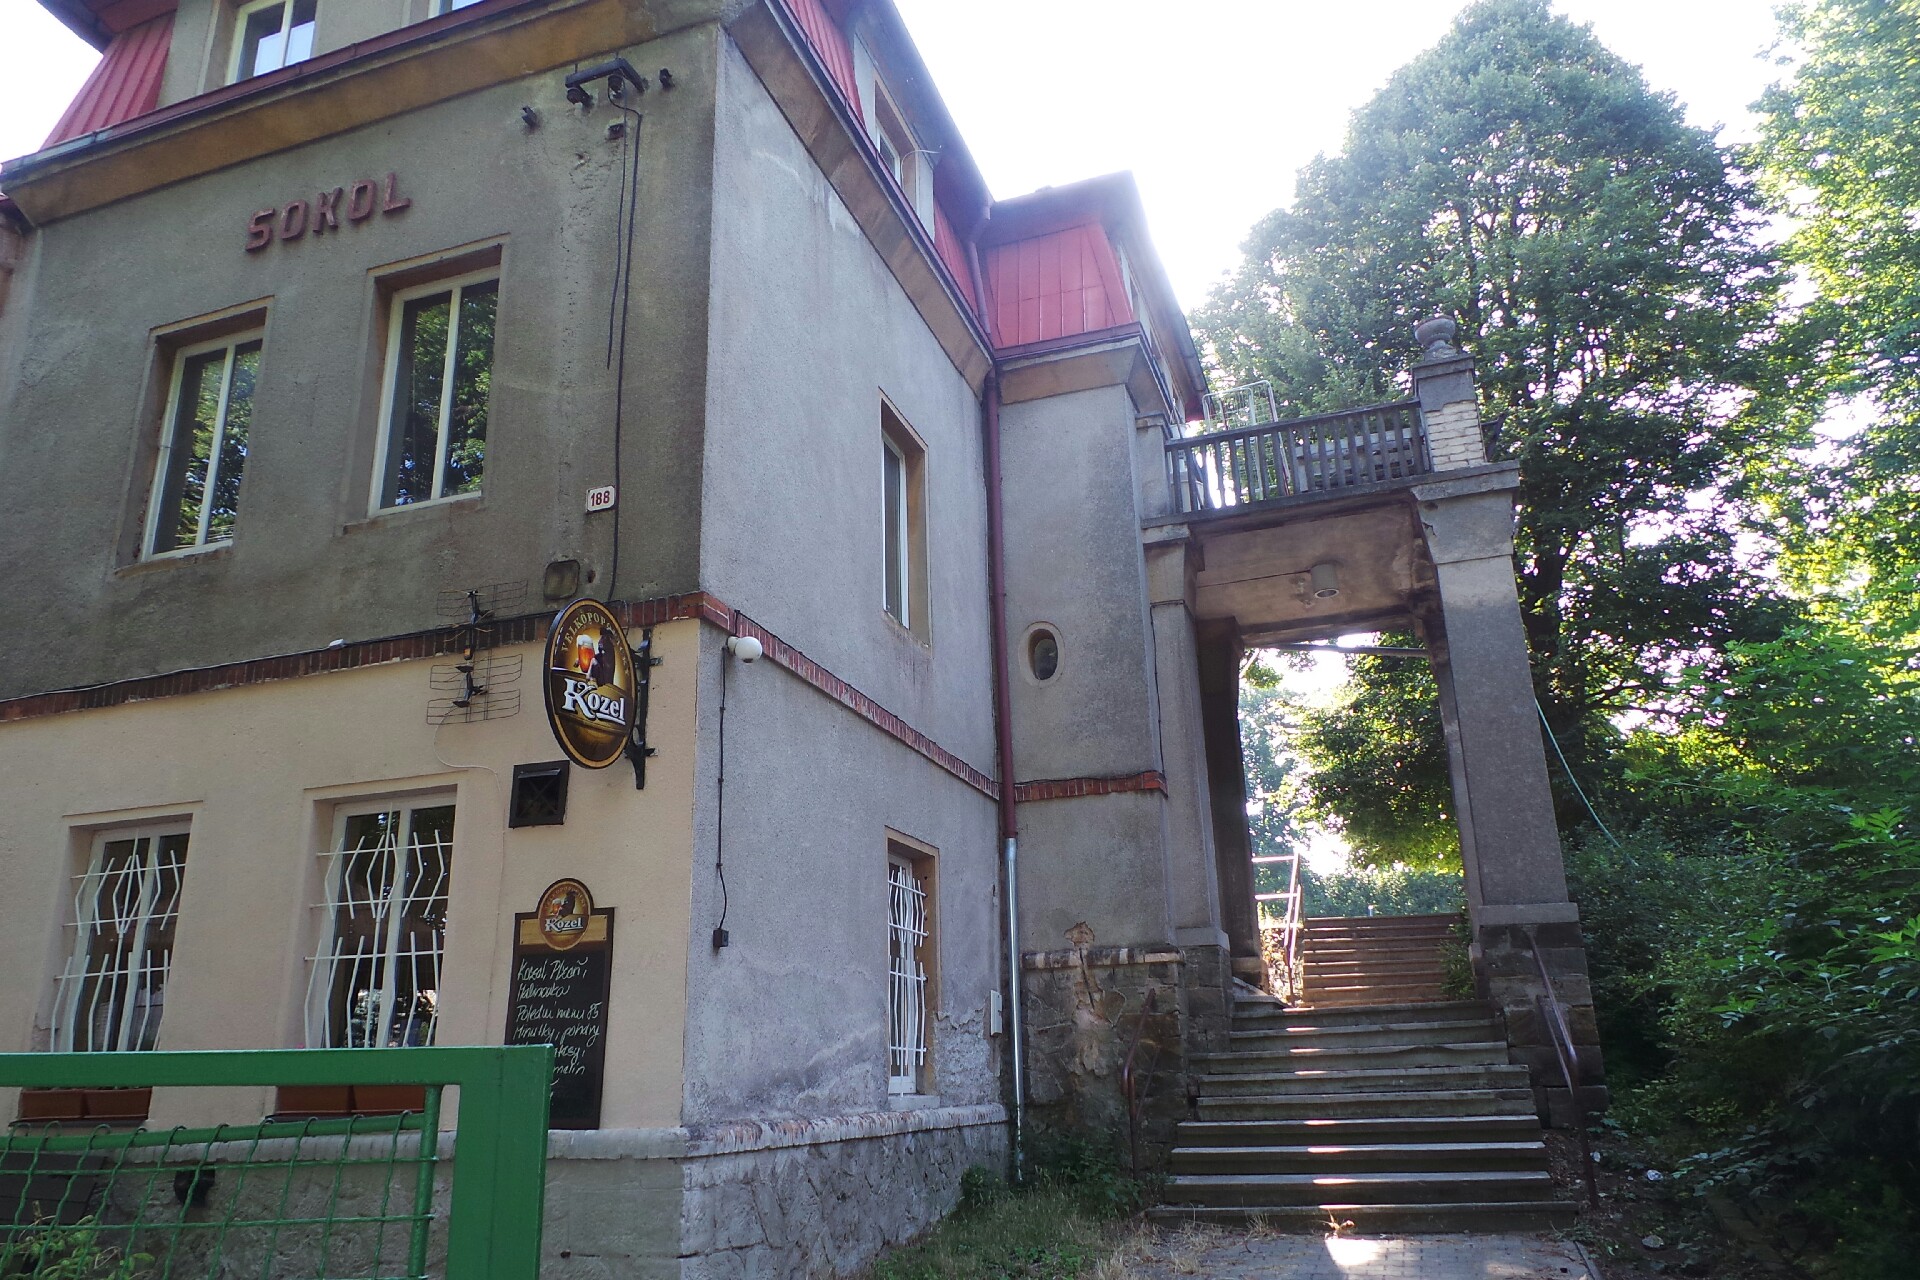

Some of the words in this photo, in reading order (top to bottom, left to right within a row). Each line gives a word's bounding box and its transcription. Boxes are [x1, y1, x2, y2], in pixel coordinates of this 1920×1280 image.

[245, 172, 411, 251] SOKOL
[591, 490, 610, 507] 188
[562, 678, 626, 725] Kozel
[545, 917, 584, 932] Kozel
